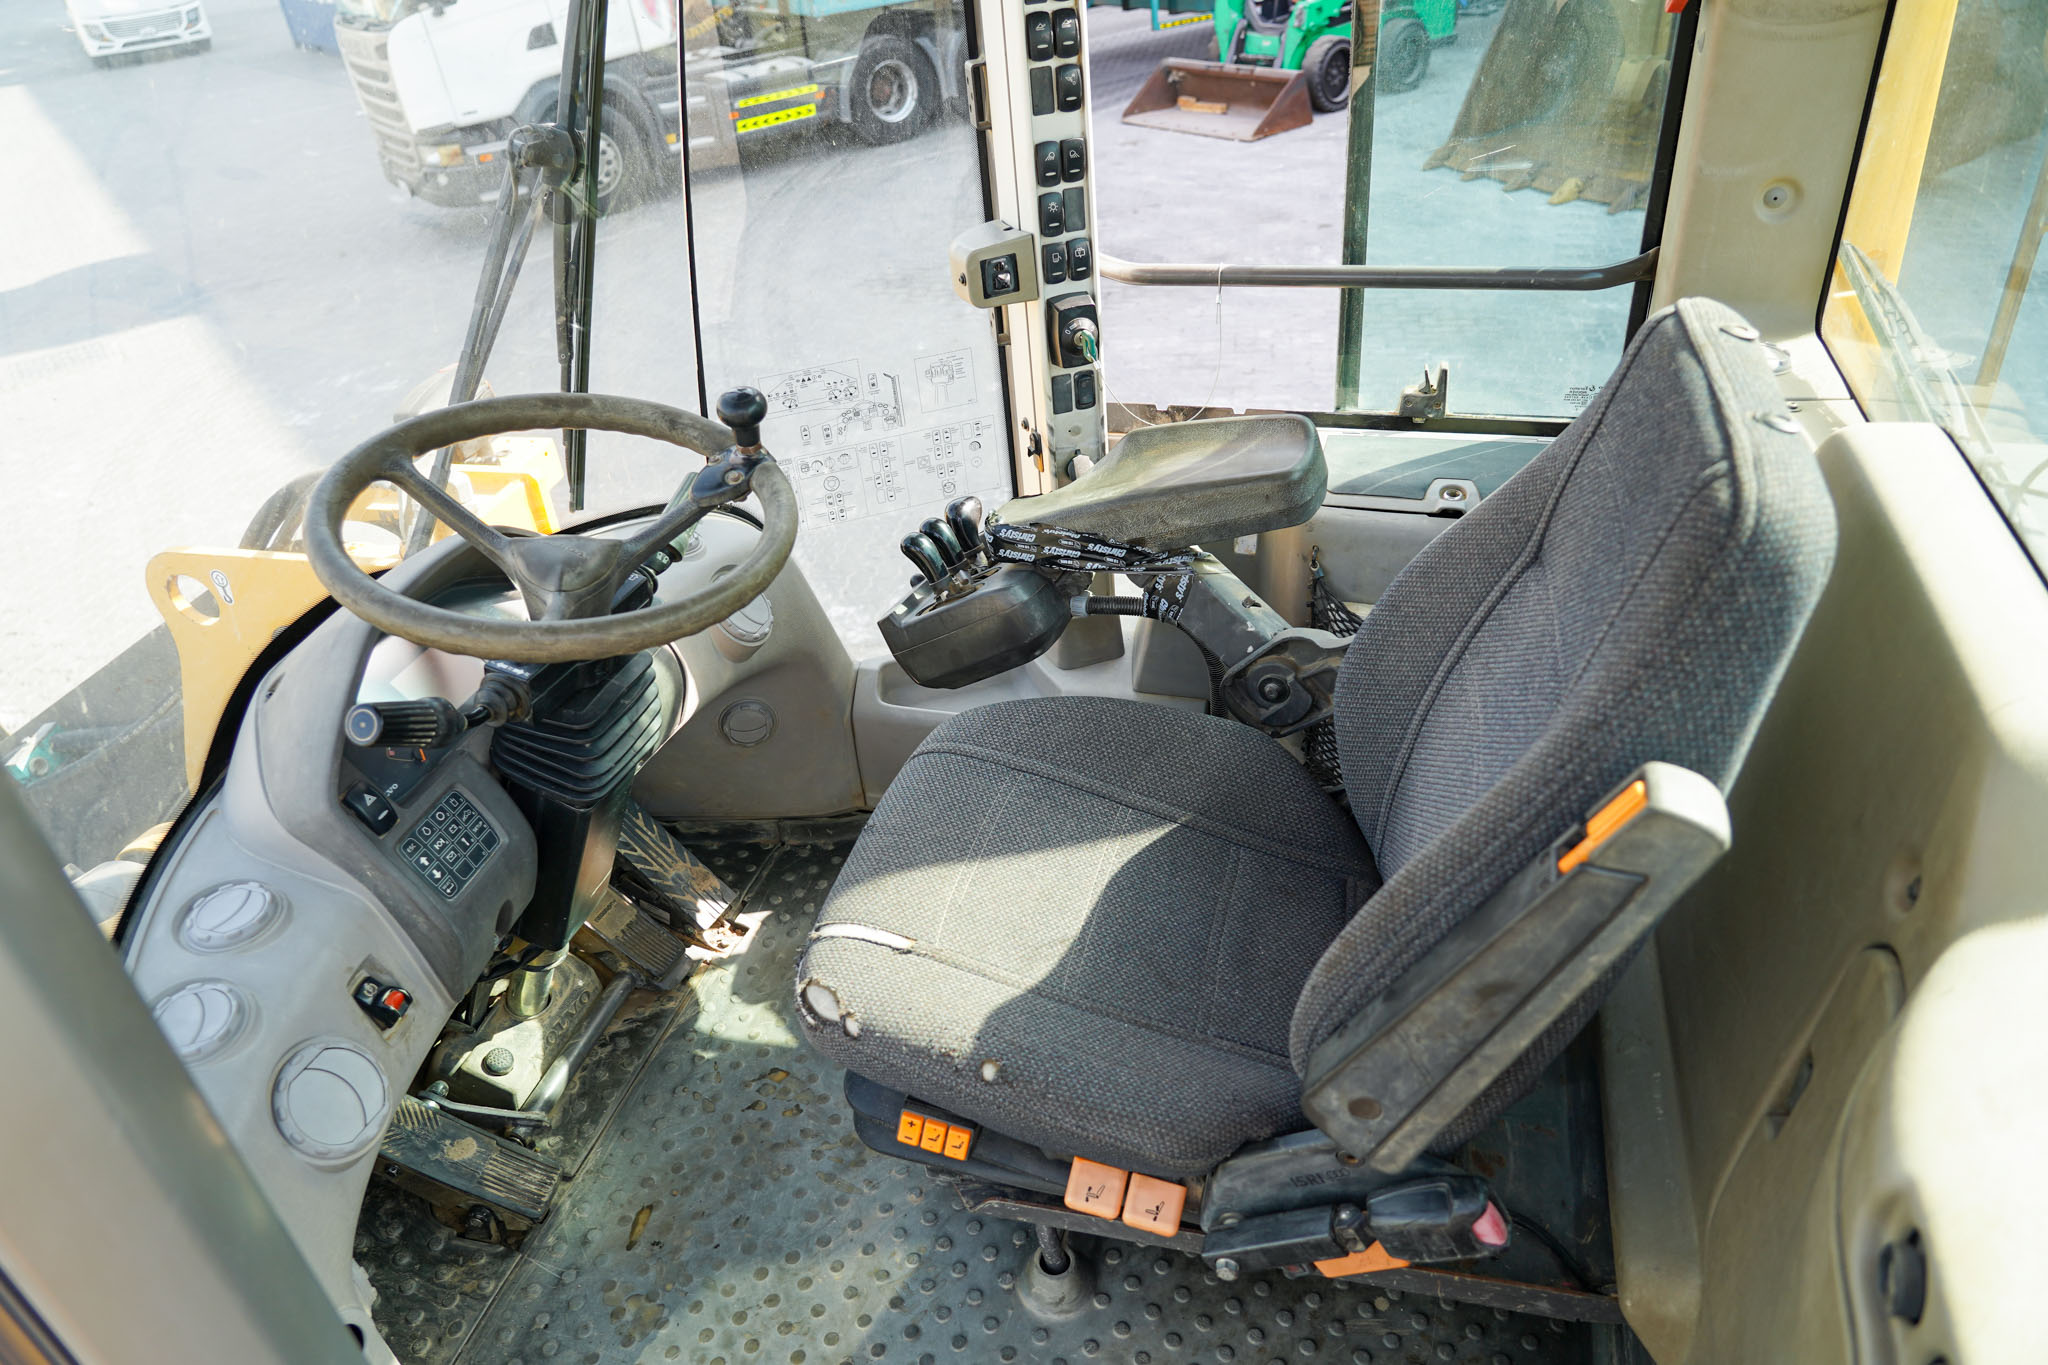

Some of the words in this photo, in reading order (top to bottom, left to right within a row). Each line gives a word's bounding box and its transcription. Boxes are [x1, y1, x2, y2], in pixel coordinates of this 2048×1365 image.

[999, 528, 1036, 542] Christy's
[999, 548, 1036, 562] Christy's
[1042, 546, 1081, 558] Christy's
[1087, 542, 1127, 558] Christy's
[406, 843, 417, 853] ESC
